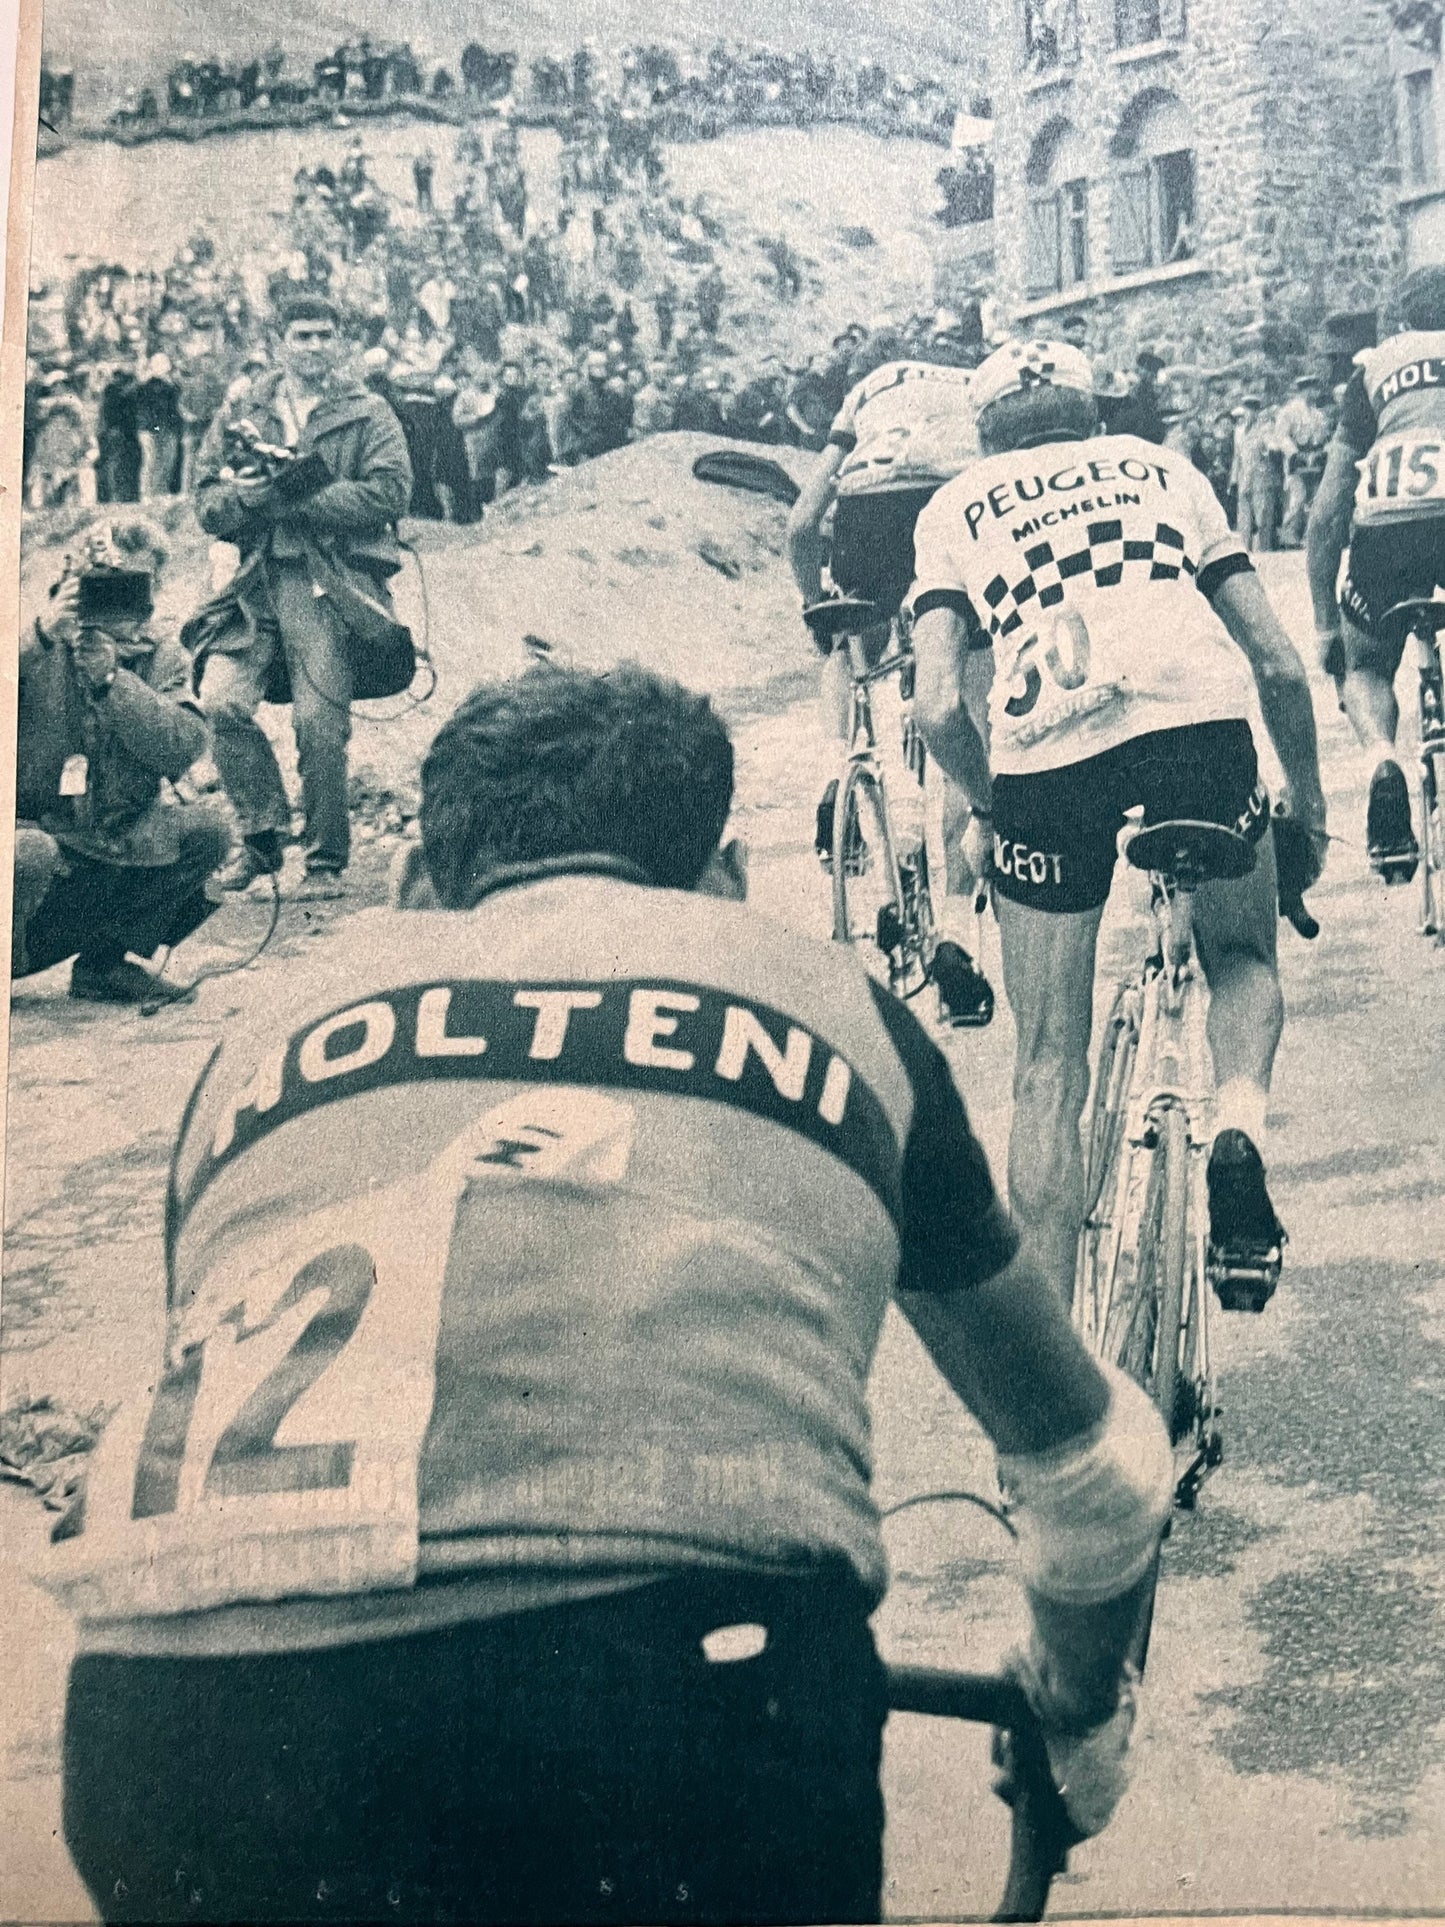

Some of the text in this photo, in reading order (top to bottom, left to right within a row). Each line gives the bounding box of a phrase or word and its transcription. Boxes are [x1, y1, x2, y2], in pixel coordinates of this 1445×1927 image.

[1382, 361, 1445, 402] MOL
[1367, 445, 1440, 498] 115
[964, 459, 1169, 541] PEUGEOT
[1012, 493, 1141, 542] MICHELIN
